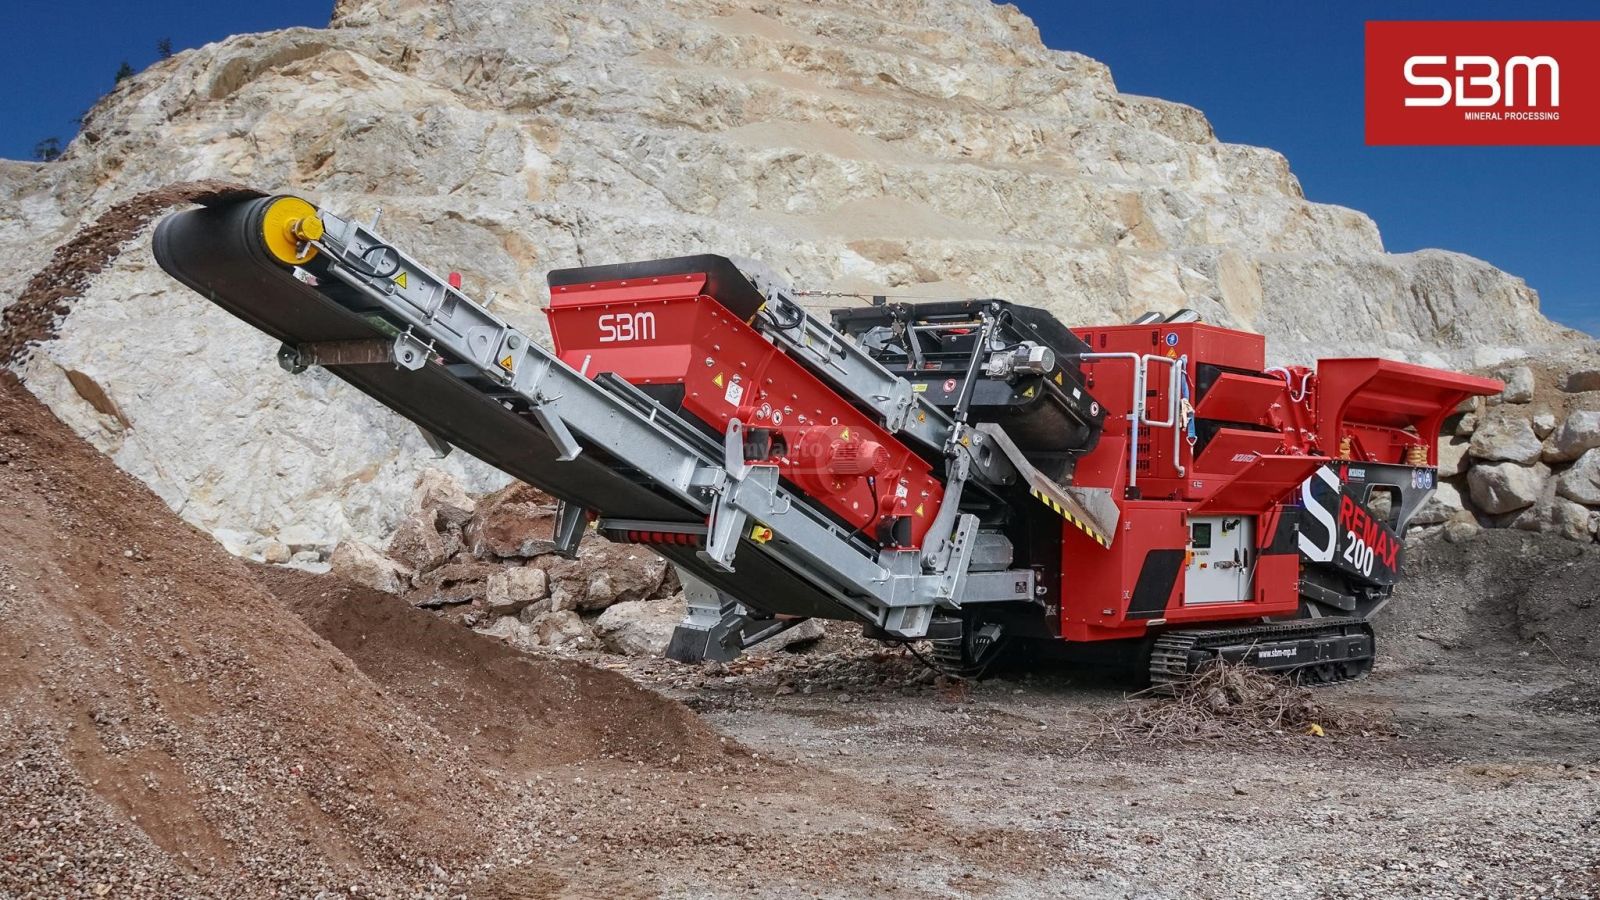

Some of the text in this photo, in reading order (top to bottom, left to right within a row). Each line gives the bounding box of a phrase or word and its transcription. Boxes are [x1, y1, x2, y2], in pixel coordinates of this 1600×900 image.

[598, 311, 656, 342] SBM
[1340, 494, 1401, 574] REMAX
[1343, 530, 1374, 577] 200
[1258, 647, 1297, 659] www.sbm-mp.at
